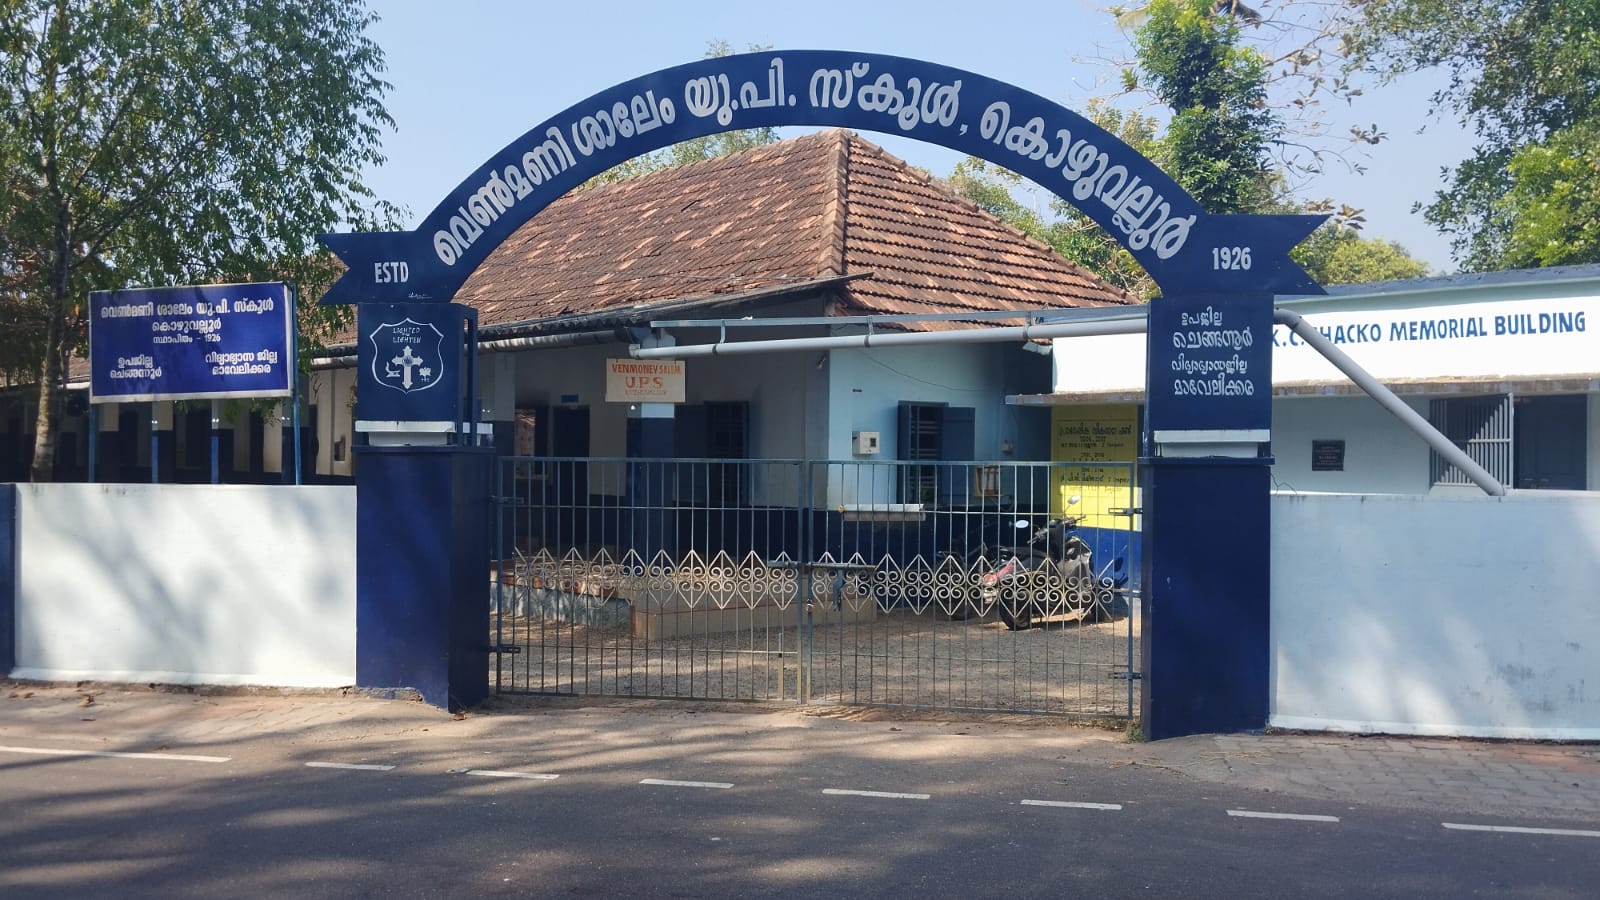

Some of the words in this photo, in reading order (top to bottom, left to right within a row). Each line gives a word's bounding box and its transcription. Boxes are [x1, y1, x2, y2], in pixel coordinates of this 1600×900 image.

[571, 89, 676, 157] ശാലേം
[1211, 246, 1252, 271] 1926
[374, 261, 409, 283] ESTD
[157, 303, 193, 316] ശാലേം
[234, 297, 274, 314] സ്കൂൾ
[204, 333, 221, 343] 1926
[1312, 323, 1382, 345] HACKO
[1389, 316, 1488, 342] MEMORIAL
[1494, 311, 1586, 336] BUILDING
